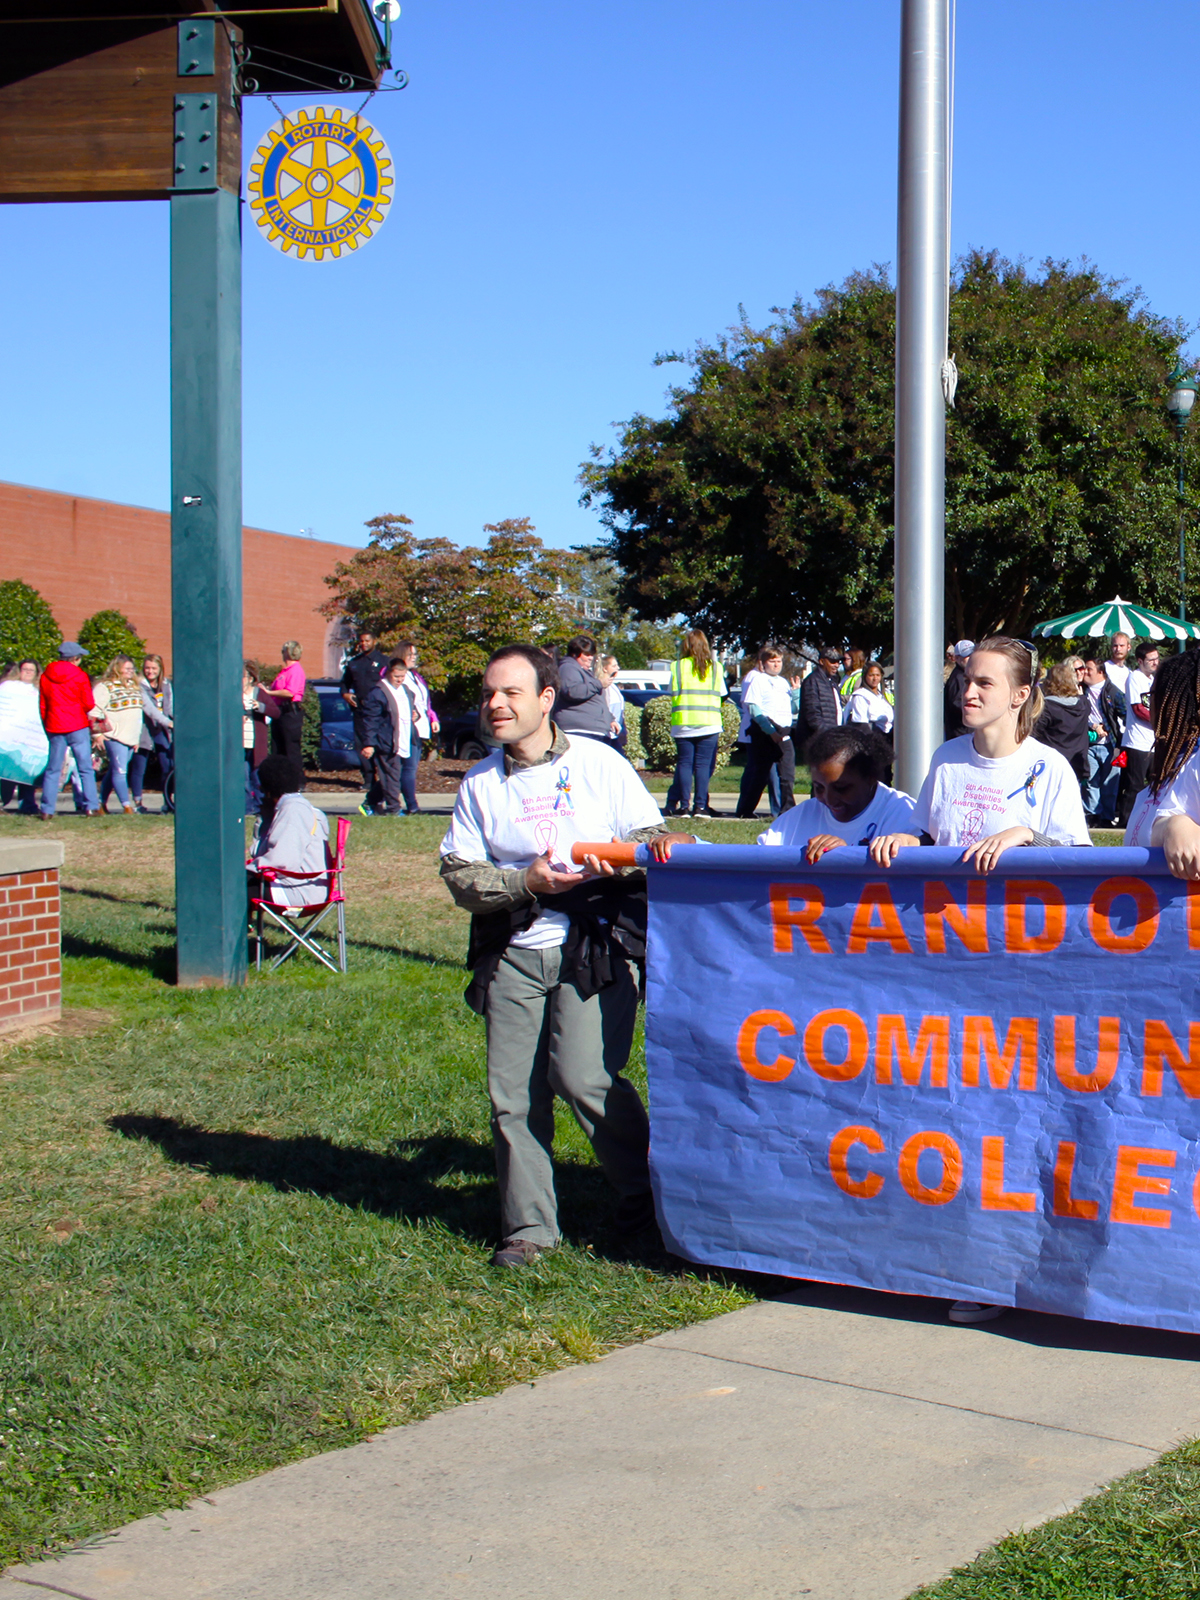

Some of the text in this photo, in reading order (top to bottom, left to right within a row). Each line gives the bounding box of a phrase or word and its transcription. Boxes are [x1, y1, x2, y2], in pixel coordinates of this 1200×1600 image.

[291, 124, 351, 142] ROTARY
[268, 205, 371, 243] INTERNATIONAL
[965, 783, 1003, 795] 6th Annual
[522, 794, 564, 805] 6th Annul
[963, 791, 1002, 803] Disabilities
[523, 802, 567, 814] Disabilites
[952, 798, 1007, 815] Awareness Day
[514, 809, 576, 824] Awareness Day
